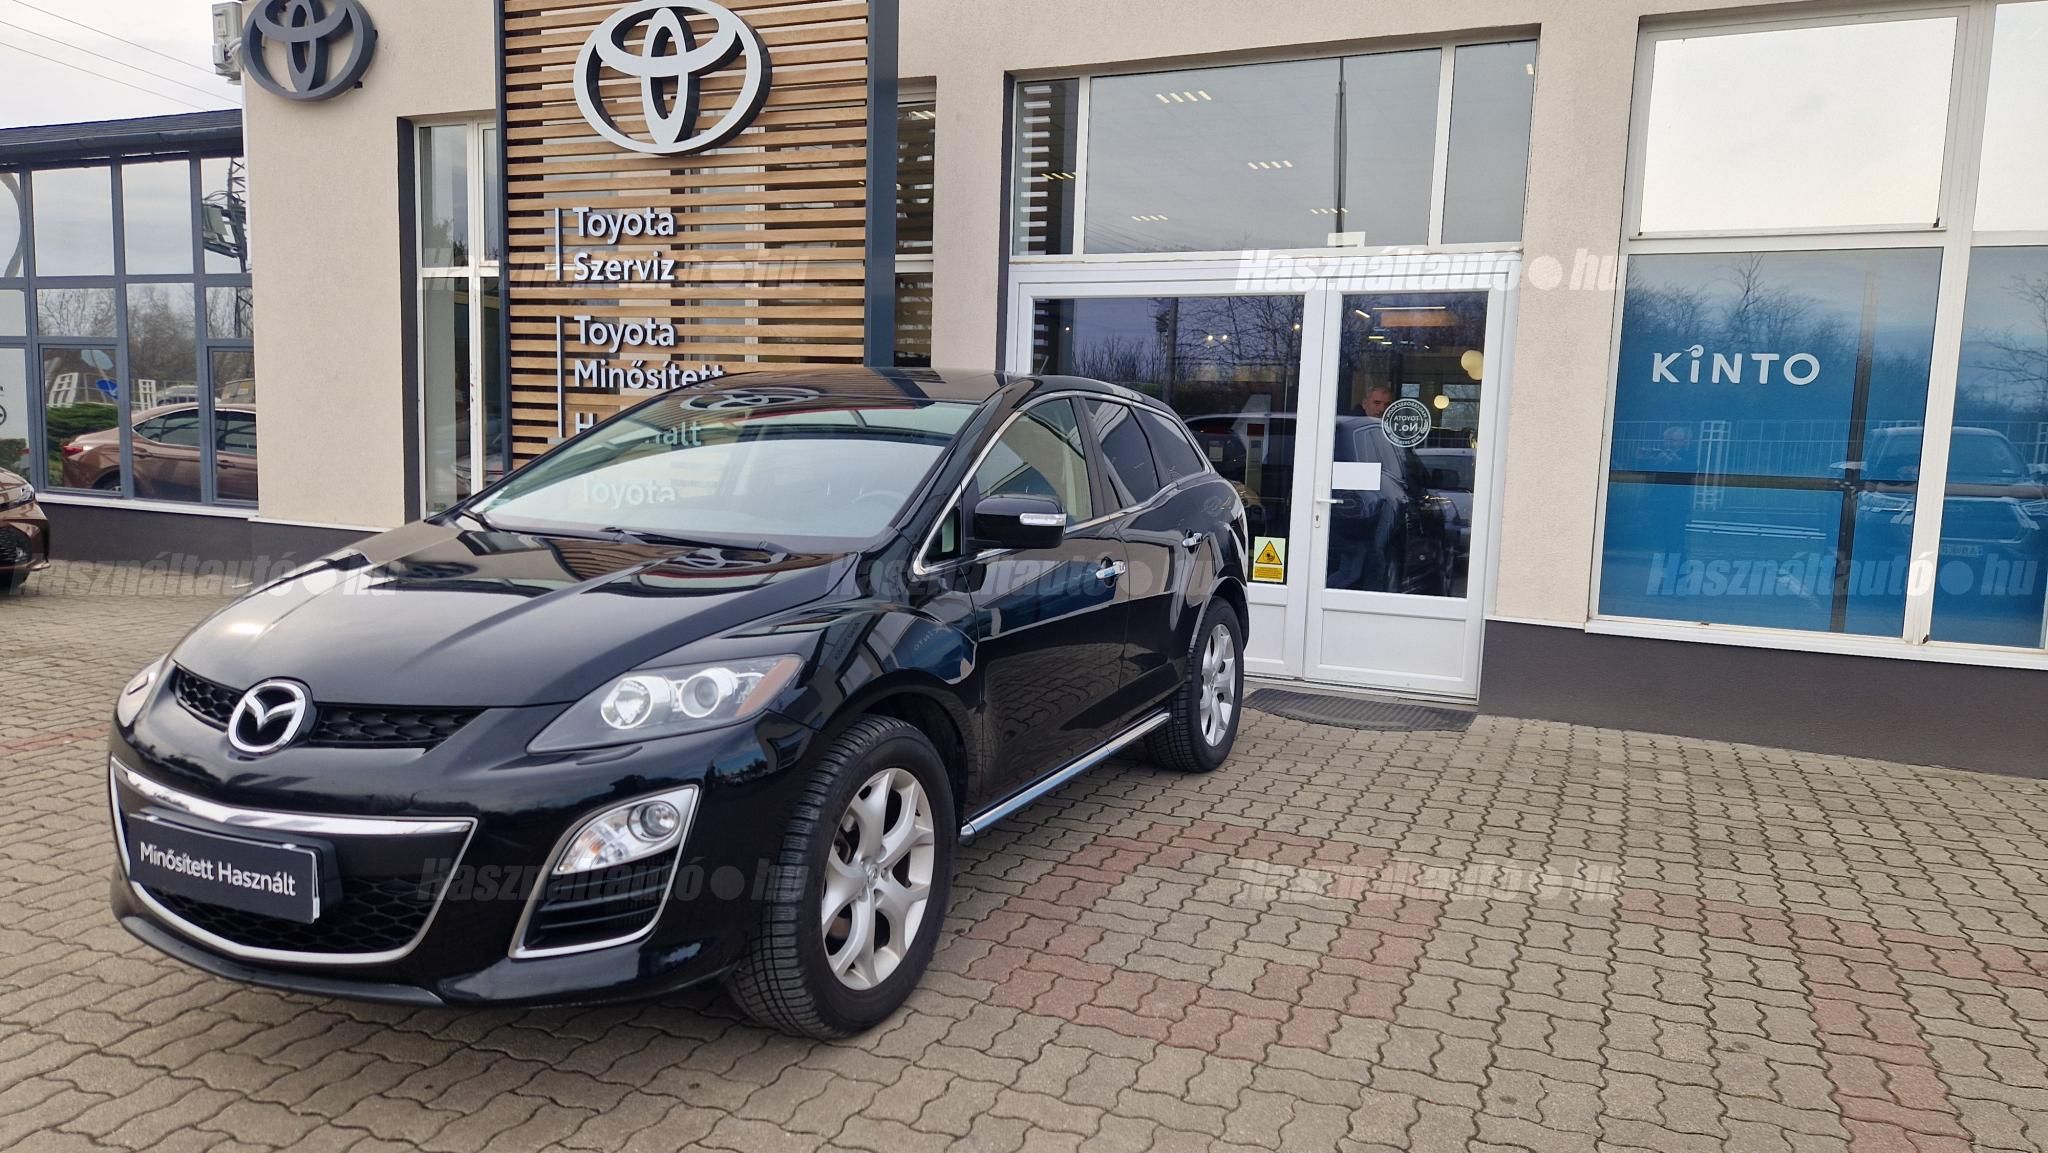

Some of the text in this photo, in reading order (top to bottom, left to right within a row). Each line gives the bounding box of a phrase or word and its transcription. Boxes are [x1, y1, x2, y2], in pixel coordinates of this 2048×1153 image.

[573, 206, 675, 245] Toyota
[573, 251, 675, 282] Szerviz
[574, 315, 675, 352] Toyota
[140, 841, 297, 897] Minősített Használt
